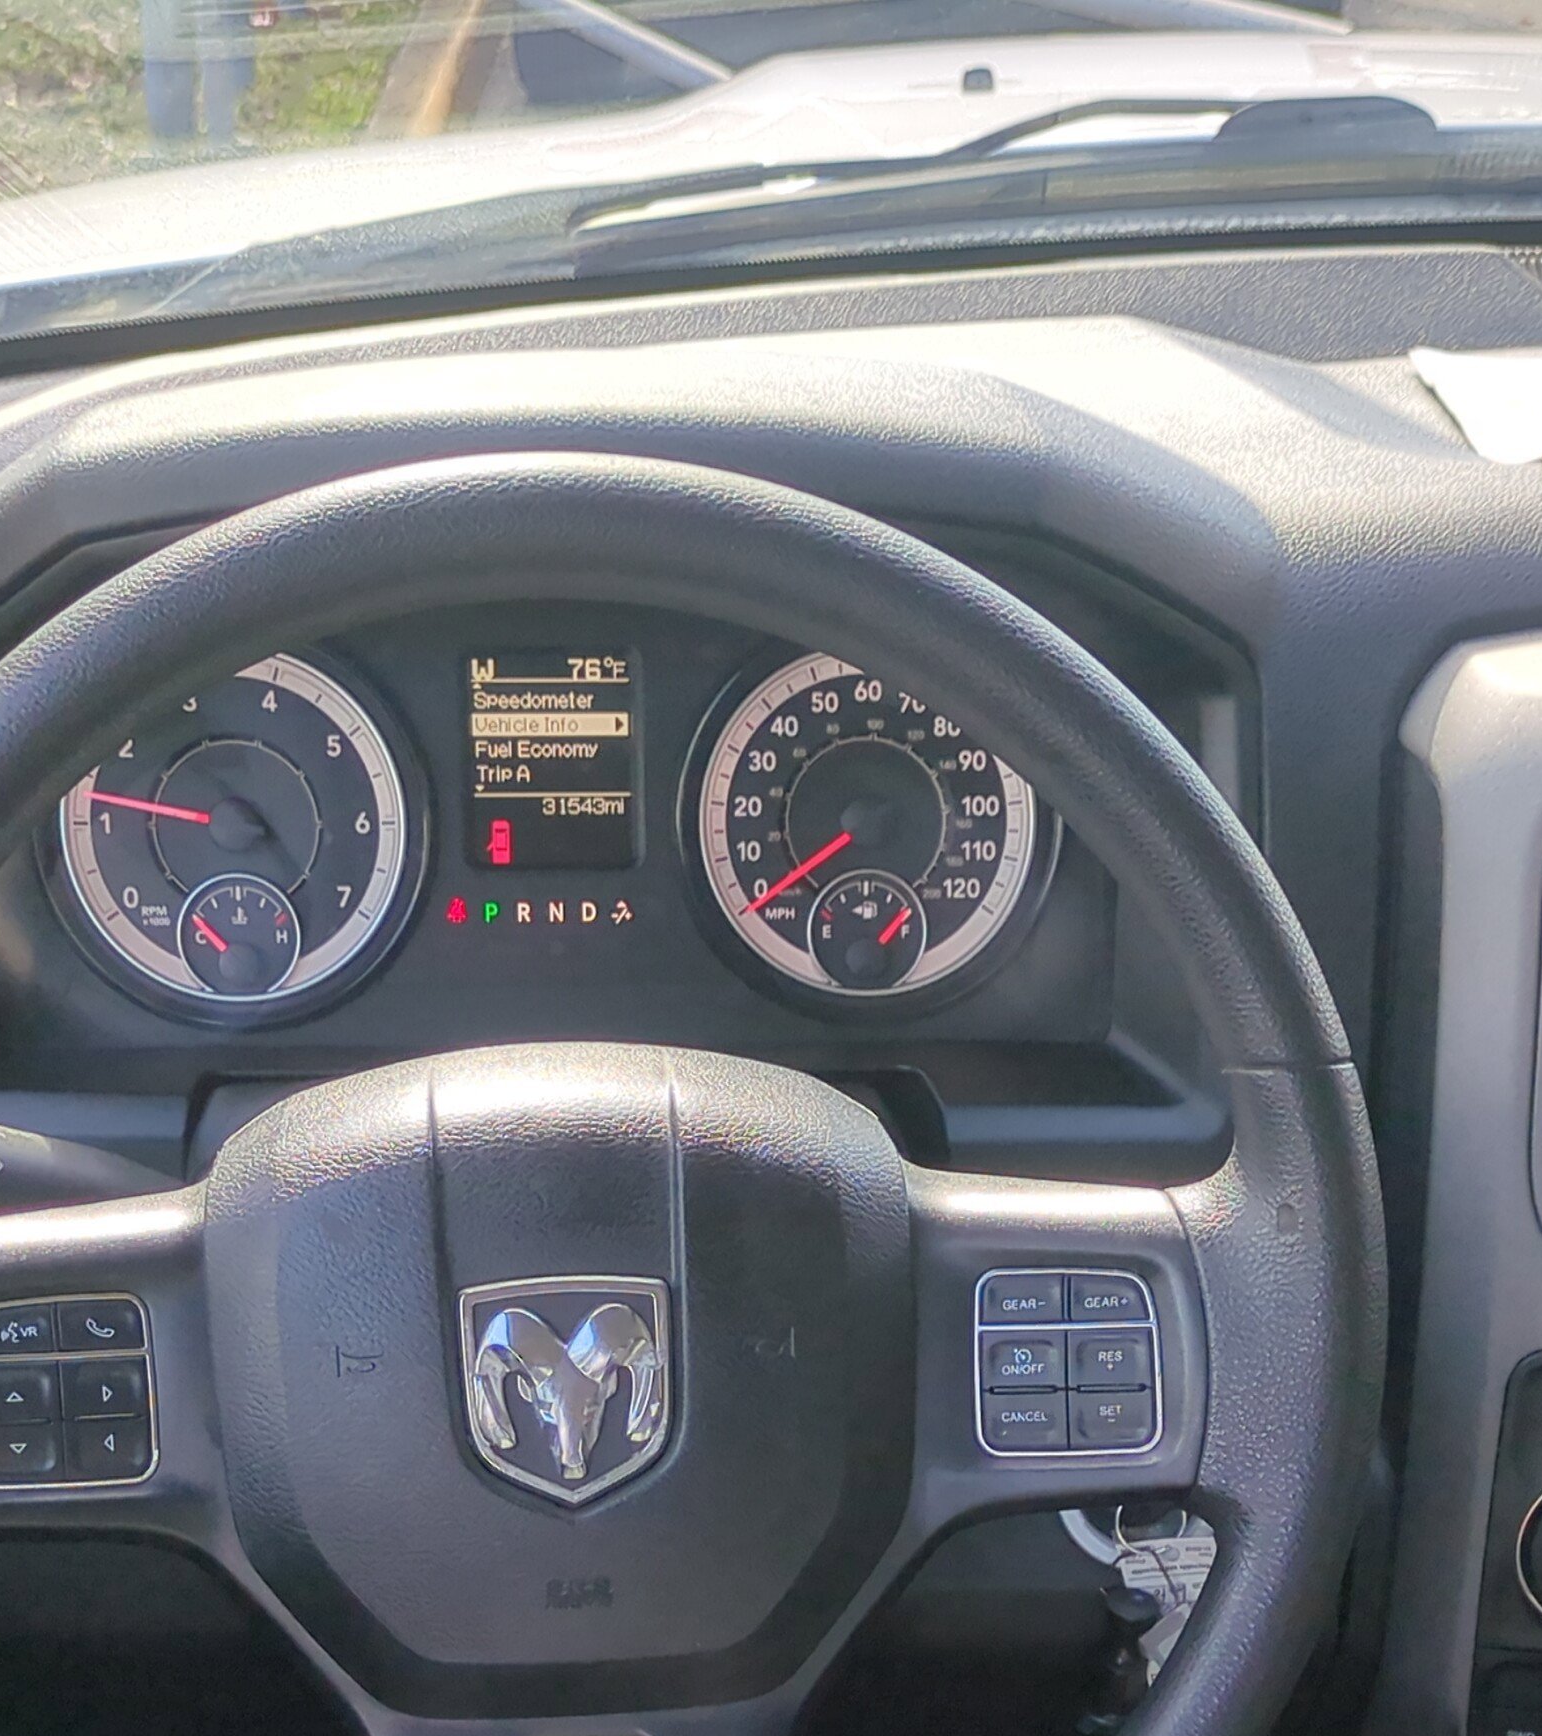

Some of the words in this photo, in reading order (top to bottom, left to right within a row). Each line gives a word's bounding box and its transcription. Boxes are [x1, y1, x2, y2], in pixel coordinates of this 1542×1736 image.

[471, 658, 495, 680] W
[567, 656, 627, 680] 76°F
[473, 691, 594, 709] Speedometer
[854, 680, 883, 701] 60
[262, 690, 278, 712] 4
[811, 691, 839, 713] 50
[475, 717, 540, 733] Vehicle
[545, 717, 579, 733] Info
[770, 715, 799, 738] 40
[118, 739, 134, 759] 2
[326, 735, 341, 757] 5
[475, 740, 512, 758] Fuel
[517, 740, 599, 759] Economy
[748, 750, 777, 772] 30
[958, 749, 987, 772] 90
[476, 764, 513, 783] Trip
[516, 764, 531, 783] A
[734, 796, 762, 817] 20
[961, 795, 1000, 817] 100
[99, 813, 112, 834] 1
[355, 812, 371, 834] 6
[736, 840, 761, 862] 10
[961, 840, 997, 862] 110
[123, 886, 139, 908] 0
[337, 886, 352, 907] 7
[754, 879, 769, 898] 0
[943, 878, 981, 899] 120
[141, 905, 168, 917] RPM
[484, 903, 499, 922] P
[517, 903, 531, 922] R
[550, 903, 564, 922] N
[582, 903, 597, 922] D
[765, 907, 796, 921] MPH
[195, 930, 208, 945] C
[275, 930, 288, 944] H
[822, 925, 832, 939] E
[901, 925, 911, 939] F
[20, 1327, 37, 1337] VR
[1097, 1351, 1123, 1362] RES
[1001, 1364, 1045, 1376] ON/OFF
[1001, 1411, 1048, 1423] CANCEL
[1099, 1405, 1122, 1416] SET
